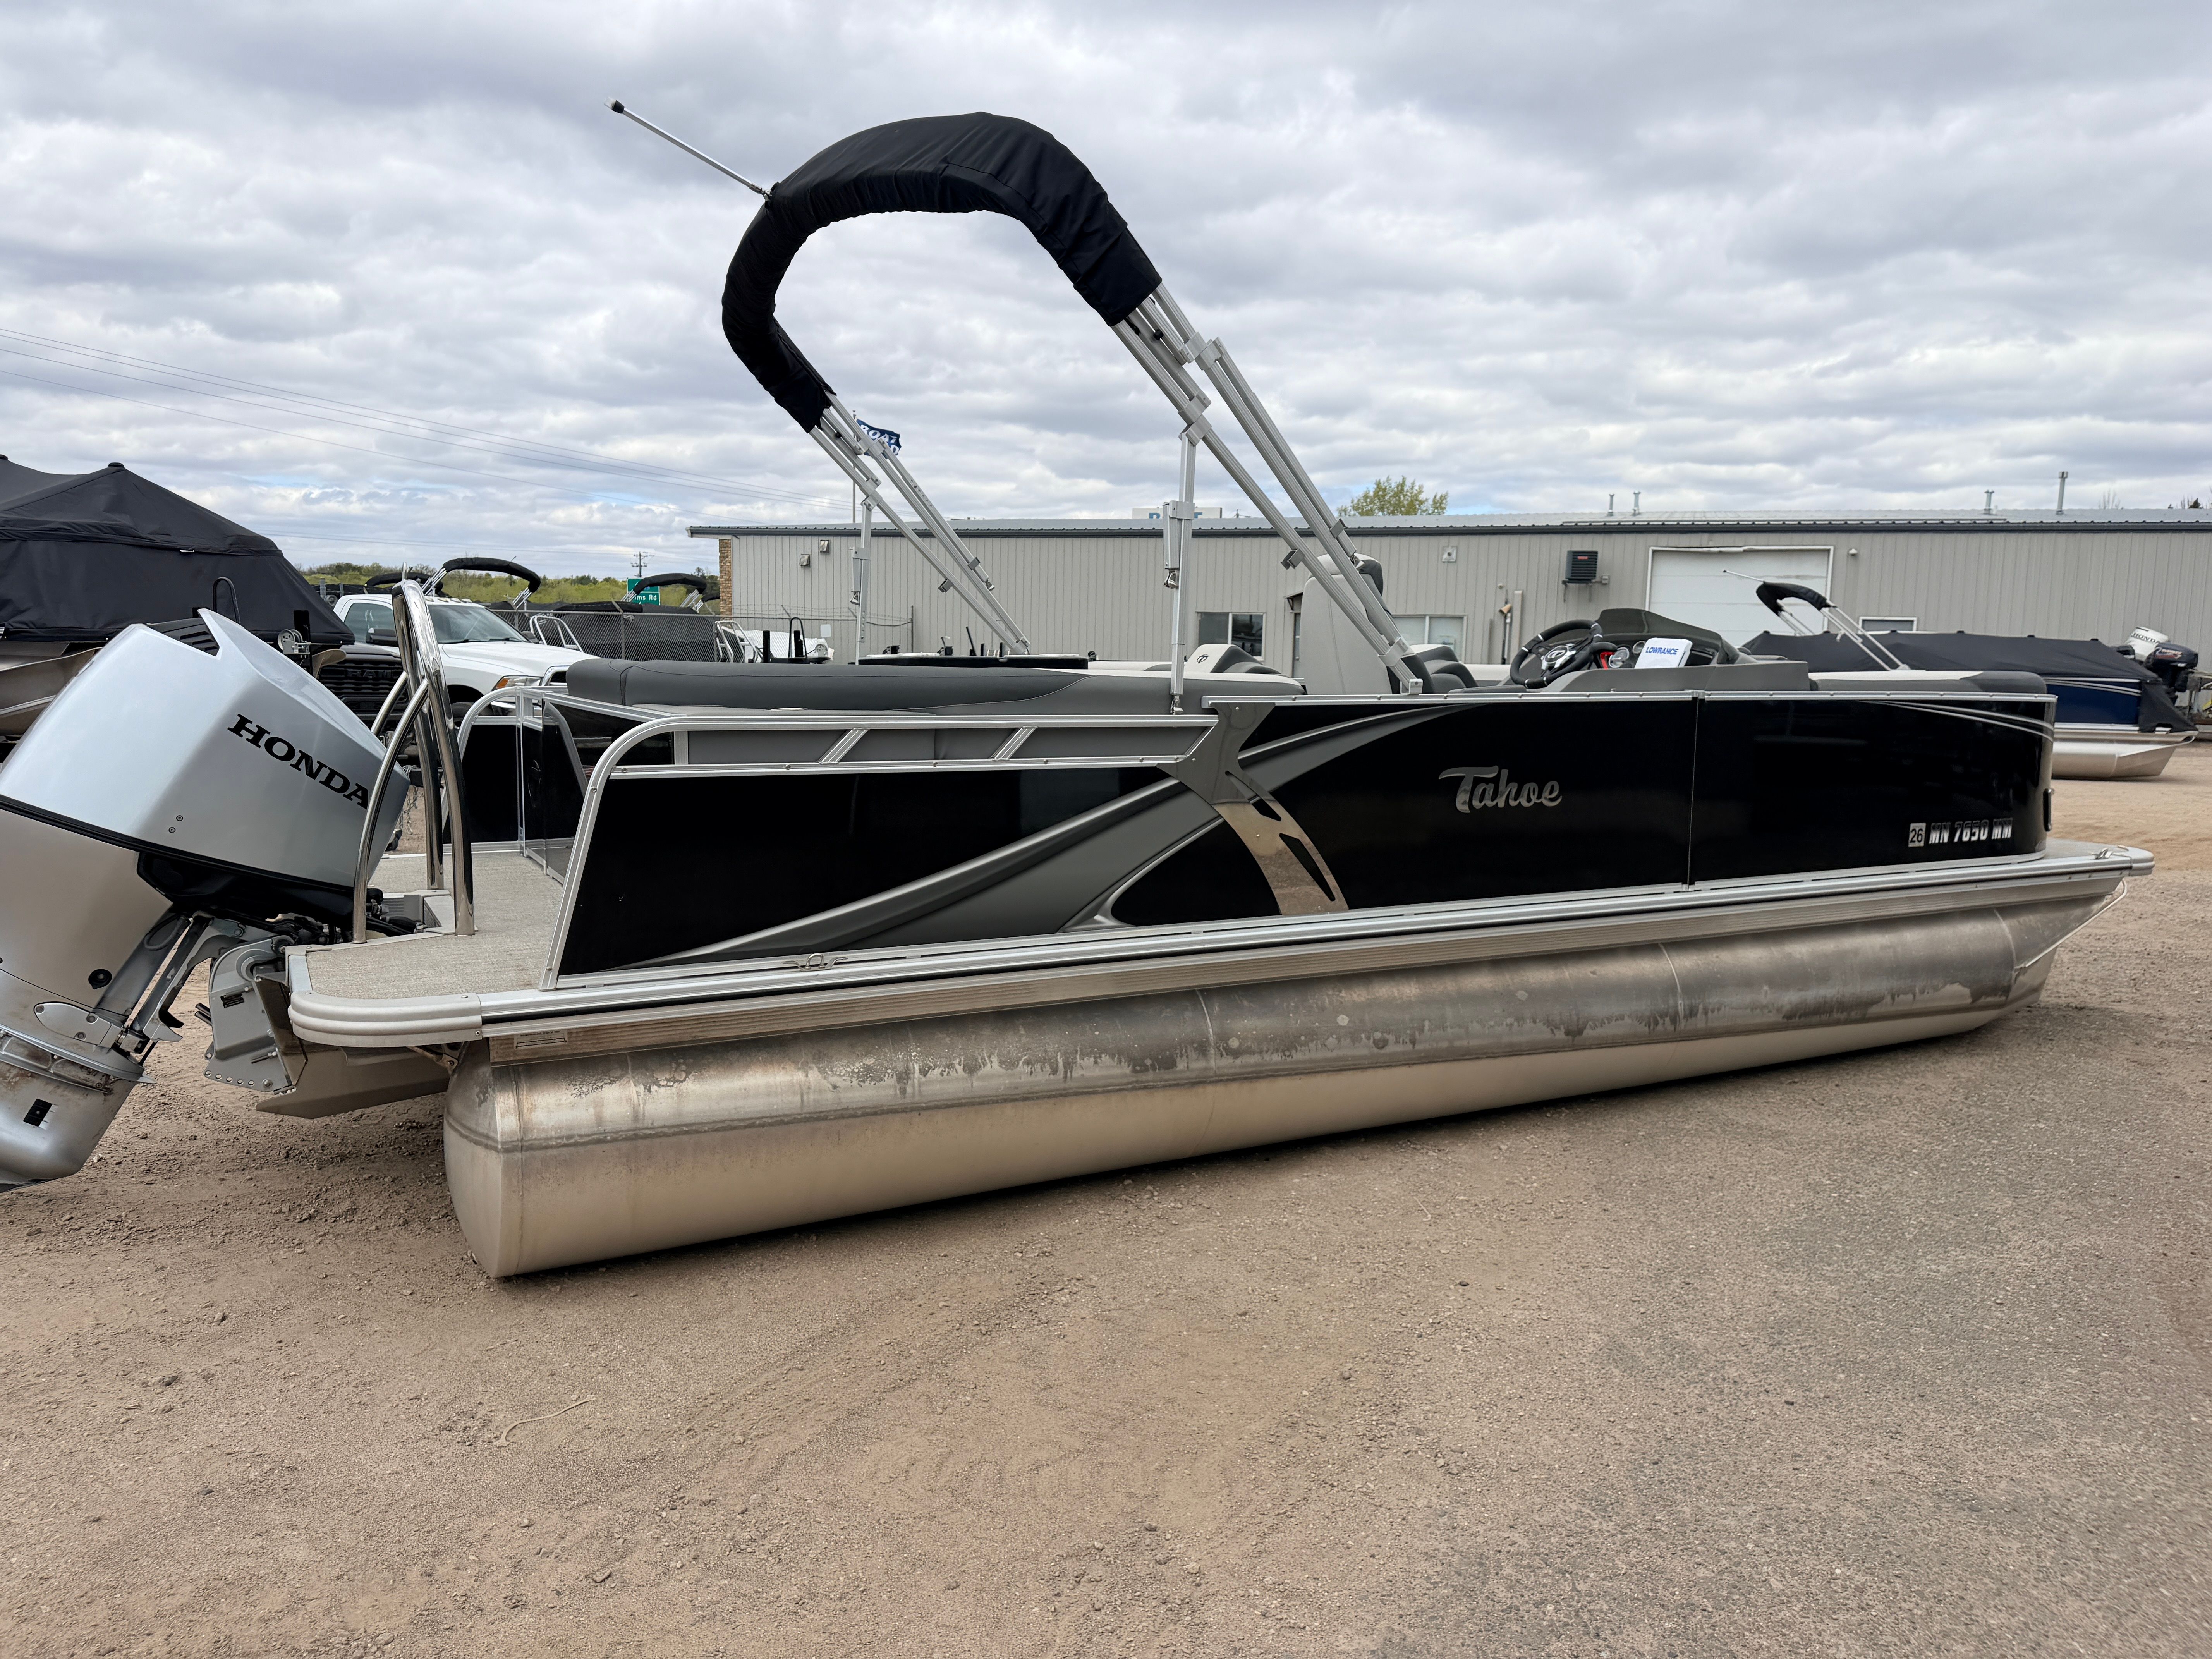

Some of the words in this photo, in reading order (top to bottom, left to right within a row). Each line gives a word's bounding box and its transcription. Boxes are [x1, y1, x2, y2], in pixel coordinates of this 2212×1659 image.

[1645, 646, 1679, 655] LOWRANCE
[2131, 632, 2160, 644] HONDA
[227, 714, 368, 810] HONDA
[1438, 765, 1562, 813] Tahoe
[1910, 828, 1923, 843] 26
[1929, 821, 1951, 844] MN
[1953, 819, 1989, 843] 7650
